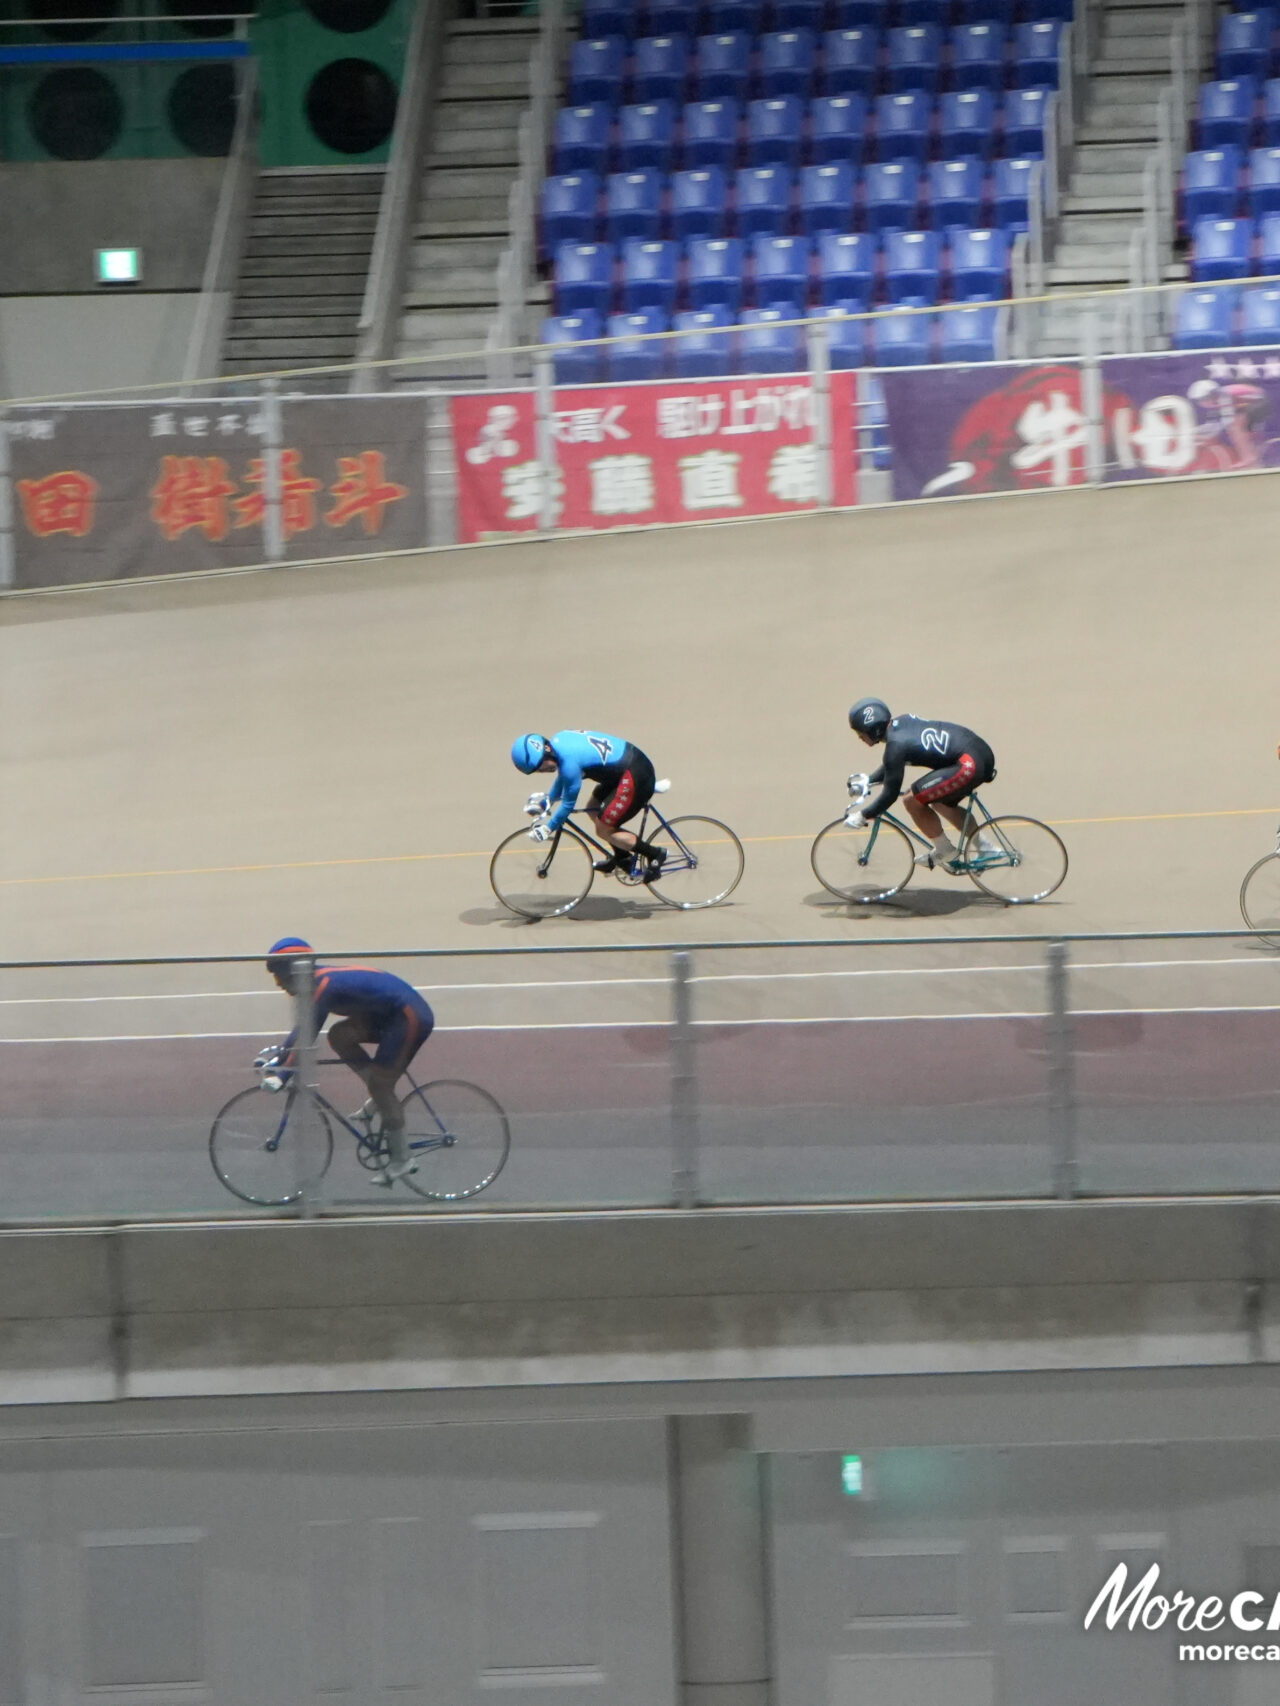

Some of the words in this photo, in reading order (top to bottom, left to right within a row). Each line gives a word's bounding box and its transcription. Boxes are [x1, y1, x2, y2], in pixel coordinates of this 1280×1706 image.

[863, 706, 875, 725] 2
[528, 738, 542, 752] 4
[587, 735, 614, 766] 4
[921, 727, 949, 755] 2
